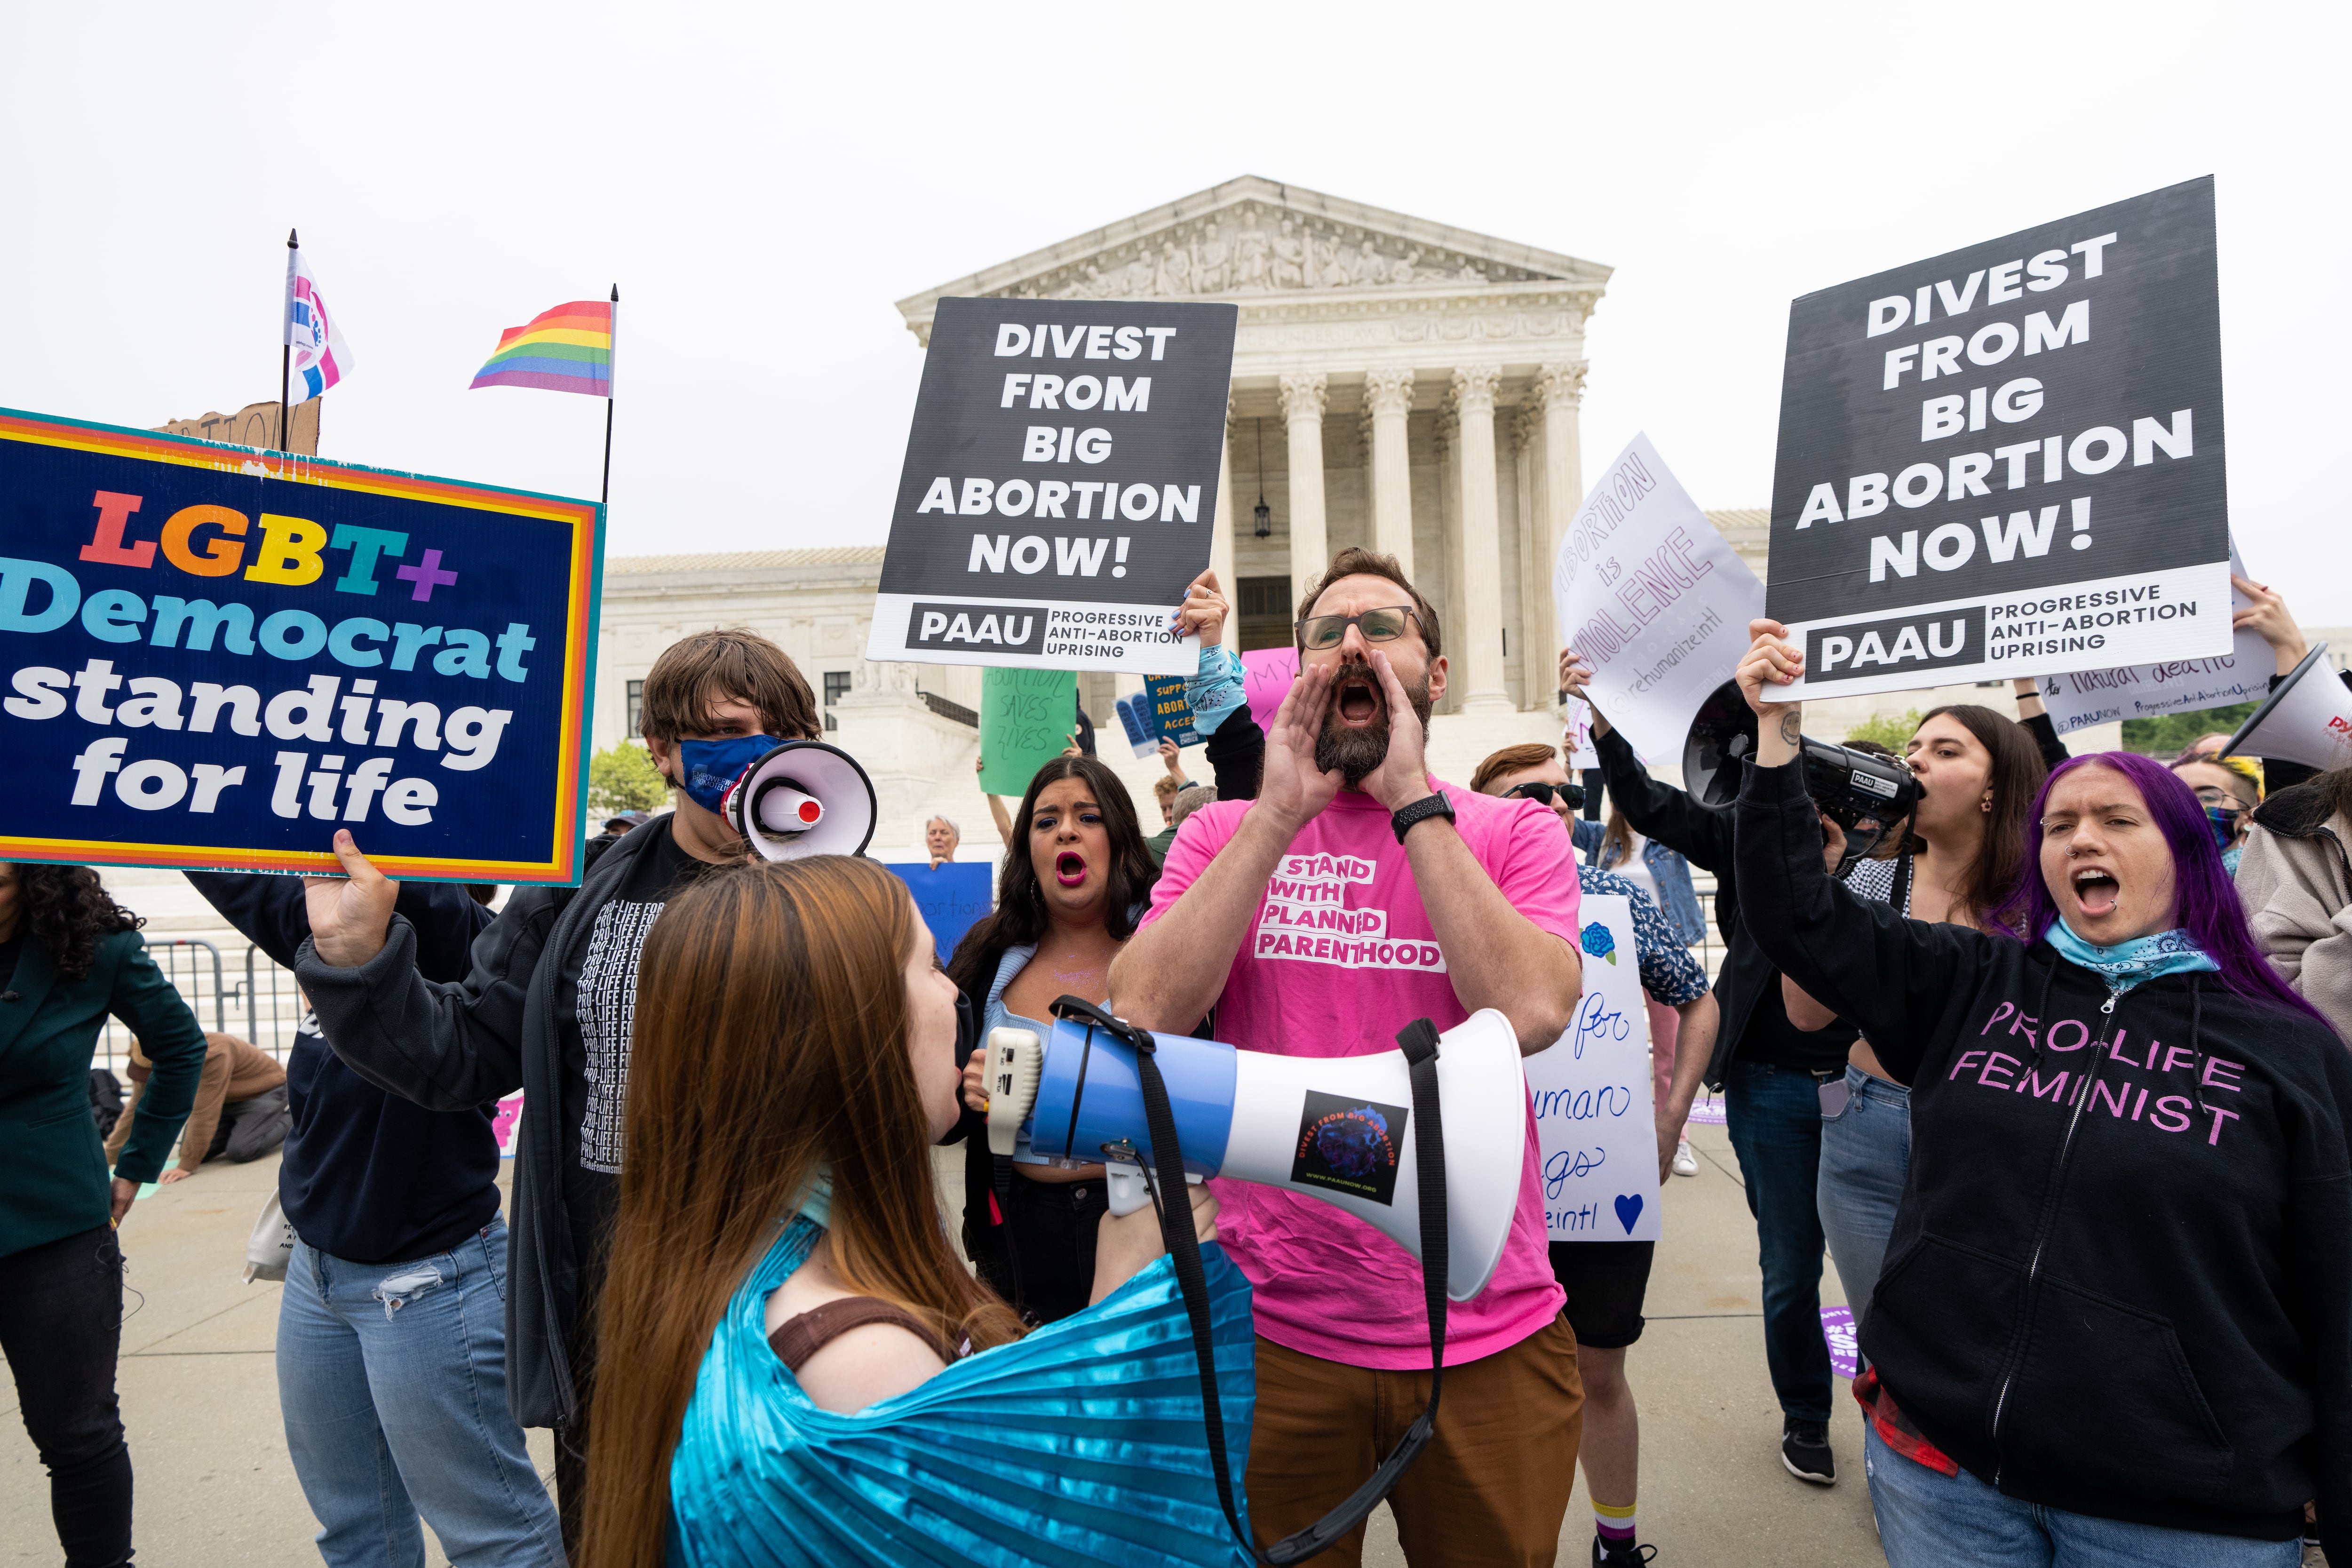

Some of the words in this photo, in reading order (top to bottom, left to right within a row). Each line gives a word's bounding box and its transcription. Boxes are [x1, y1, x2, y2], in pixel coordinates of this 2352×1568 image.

[1867, 232, 2117, 339] DIVEST
[994, 323, 1176, 361] DIVEST
[1883, 299, 2090, 391] FROM
[1001, 373, 1152, 412] FROM
[1921, 377, 2043, 443] BIG
[1022, 426, 1112, 464] BIG
[1795, 408, 2193, 531] ABORTION
[916, 477, 1201, 523] ABORTION
[79, 490, 459, 602] LGBT+
[1869, 496, 2092, 583] NOW!
[968, 534, 1130, 578] NOW!
[1596, 556, 1621, 587] is
[1568, 526, 1713, 675] VIOLENCE
[1991, 584, 2160, 620] PROGRESSIVE
[0, 557, 536, 683] Democrat
[919, 611, 1033, 645] PAAU
[1051, 611, 1163, 628] PROGRESSIVE
[1991, 601, 2197, 640] ANTI-ABORTION
[1049, 627, 1183, 645] ANTI-ABORTION
[1820, 619, 1965, 672] PAAU
[1991, 635, 2105, 660] UPRISING
[1047, 643, 1124, 658] UPRISING
[1253, 653, 1295, 691] MY
[2070, 667, 2140, 693] natural
[1157, 683, 1187, 696] SUPPO
[3, 659, 513, 772] standing
[1000, 694, 1053, 727] SAVES
[1157, 699, 1189, 715] ABORT
[2058, 707, 2121, 734] @PAAUNOW
[2135, 682, 2269, 715] ProgressiveAntiAbortionUprisin
[1165, 716, 1195, 730] ACCES
[71, 737, 246, 813] for
[271, 750, 438, 826] life
[692, 771, 736, 787] EMPOWERWO
[692, 775, 729, 792] PROMOTELI
[1854, 774, 1874, 787] PAAU
[1286, 856, 1371, 879] STAND
[1270, 877, 1340, 902] WITH
[598, 899, 642, 916] PRO-LIFE
[644, 902, 664, 914] FOR
[918, 890, 987, 918] ortion
[591, 923, 636, 942] PRO-LIFE
[636, 924, 652, 936] FO
[595, 912, 639, 930] PRO-LIFE
[1263, 904, 1381, 934] PLANNED
[583, 948, 628, 967] PRO-LIFE
[630, 947, 643, 961] FO
[588, 935, 632, 955] PRO-LIFE
[633, 936, 647, 948] FO
[1258, 933, 1440, 967] PARENTHOOD
[577, 975, 622, 994] PRO-LIFE
[624, 975, 638, 989] FO
[580, 961, 625, 980] PRO-LIFE
[627, 961, 641, 974] FO
[577, 990, 620, 1009] PRO-LIFE
[622, 989, 636, 1005] FO
[576, 1005, 618, 1023] PRO-LIFE
[621, 1004, 635, 1020] FO
[1575, 992, 1629, 1059] for
[580, 1020, 618, 1038] PRO-LIFE
[620, 1020, 634, 1037] FO
[583, 1037, 617, 1053] PRO-LIFE
[620, 1036, 633, 1053] FO
[1981, 1002, 2245, 1092] PRO-LIFE
[586, 1052, 616, 1068] PRO-LIFE
[619, 1052, 632, 1068] FO
[584, 1067, 616, 1084] PRO-LIFE
[618, 1068, 631, 1084] FO
[587, 1096, 614, 1116] PRO-LIFE
[1534, 1086, 1630, 1120] uman
[1948, 1051, 2239, 1146] FEMINIST
[582, 1111, 613, 1131] PRO-LIFE
[580, 1126, 612, 1146] PRO-LIFE
[1299, 1125, 1318, 1158] DIVEST
[1318, 1112, 1345, 1126] FROM
[1348, 1112, 1366, 1122] BIG
[1367, 1120, 1395, 1166] ABORTION
[580, 1157, 623, 1175] @TakeFeminismB
[581, 1141, 612, 1163] PRO-LIFE
[1306, 1172, 1377, 1193] WWW.PAAUNOW.ORG
[1542, 1146, 1605, 1200] gs
[1545, 1202, 1597, 1231] eintl
